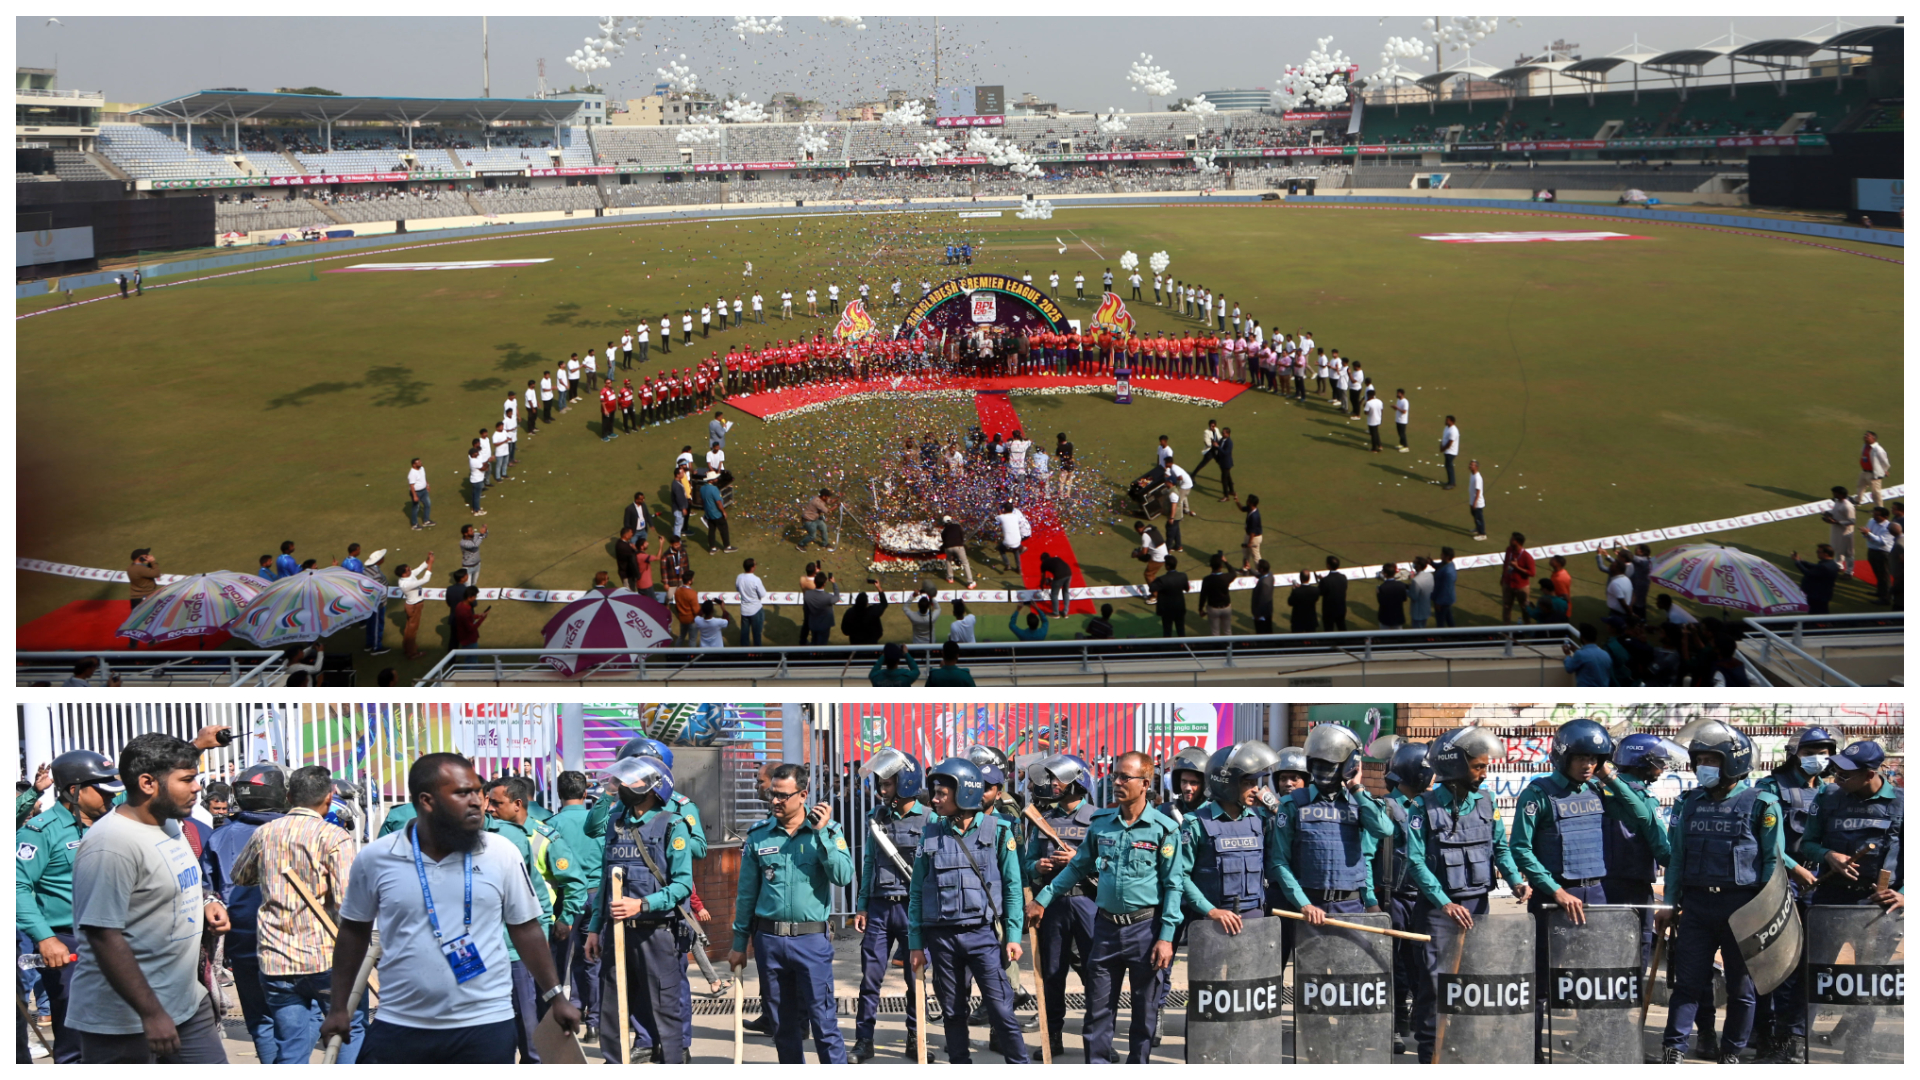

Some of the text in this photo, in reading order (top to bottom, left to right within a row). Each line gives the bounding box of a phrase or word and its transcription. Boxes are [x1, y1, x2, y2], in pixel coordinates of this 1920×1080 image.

[906, 276, 1063, 327] BANGLADESH PREMIER LEAGUE 2025
[1709, 597, 1748, 609] ROCKET
[168, 627, 207, 638] ROCKET
[1733, 747, 1750, 758] POLICE
[964, 780, 982, 788] POLICE
[1210, 774, 1229, 783] POLICE
[1559, 799, 1602, 816] POLICE
[1301, 808, 1357, 822] POLICE
[1690, 821, 1731, 832] POLICE
[1835, 818, 1881, 829] POLICE
[1053, 827, 1085, 838] LICE
[177, 866, 198, 893] PUMA
[1558, 976, 1637, 1000] POLICE
[1817, 973, 1904, 996] POLICE
[1198, 985, 1277, 1013] POLICE
[1304, 982, 1386, 1006] POLICE
[1447, 982, 1529, 1007] POLICE
